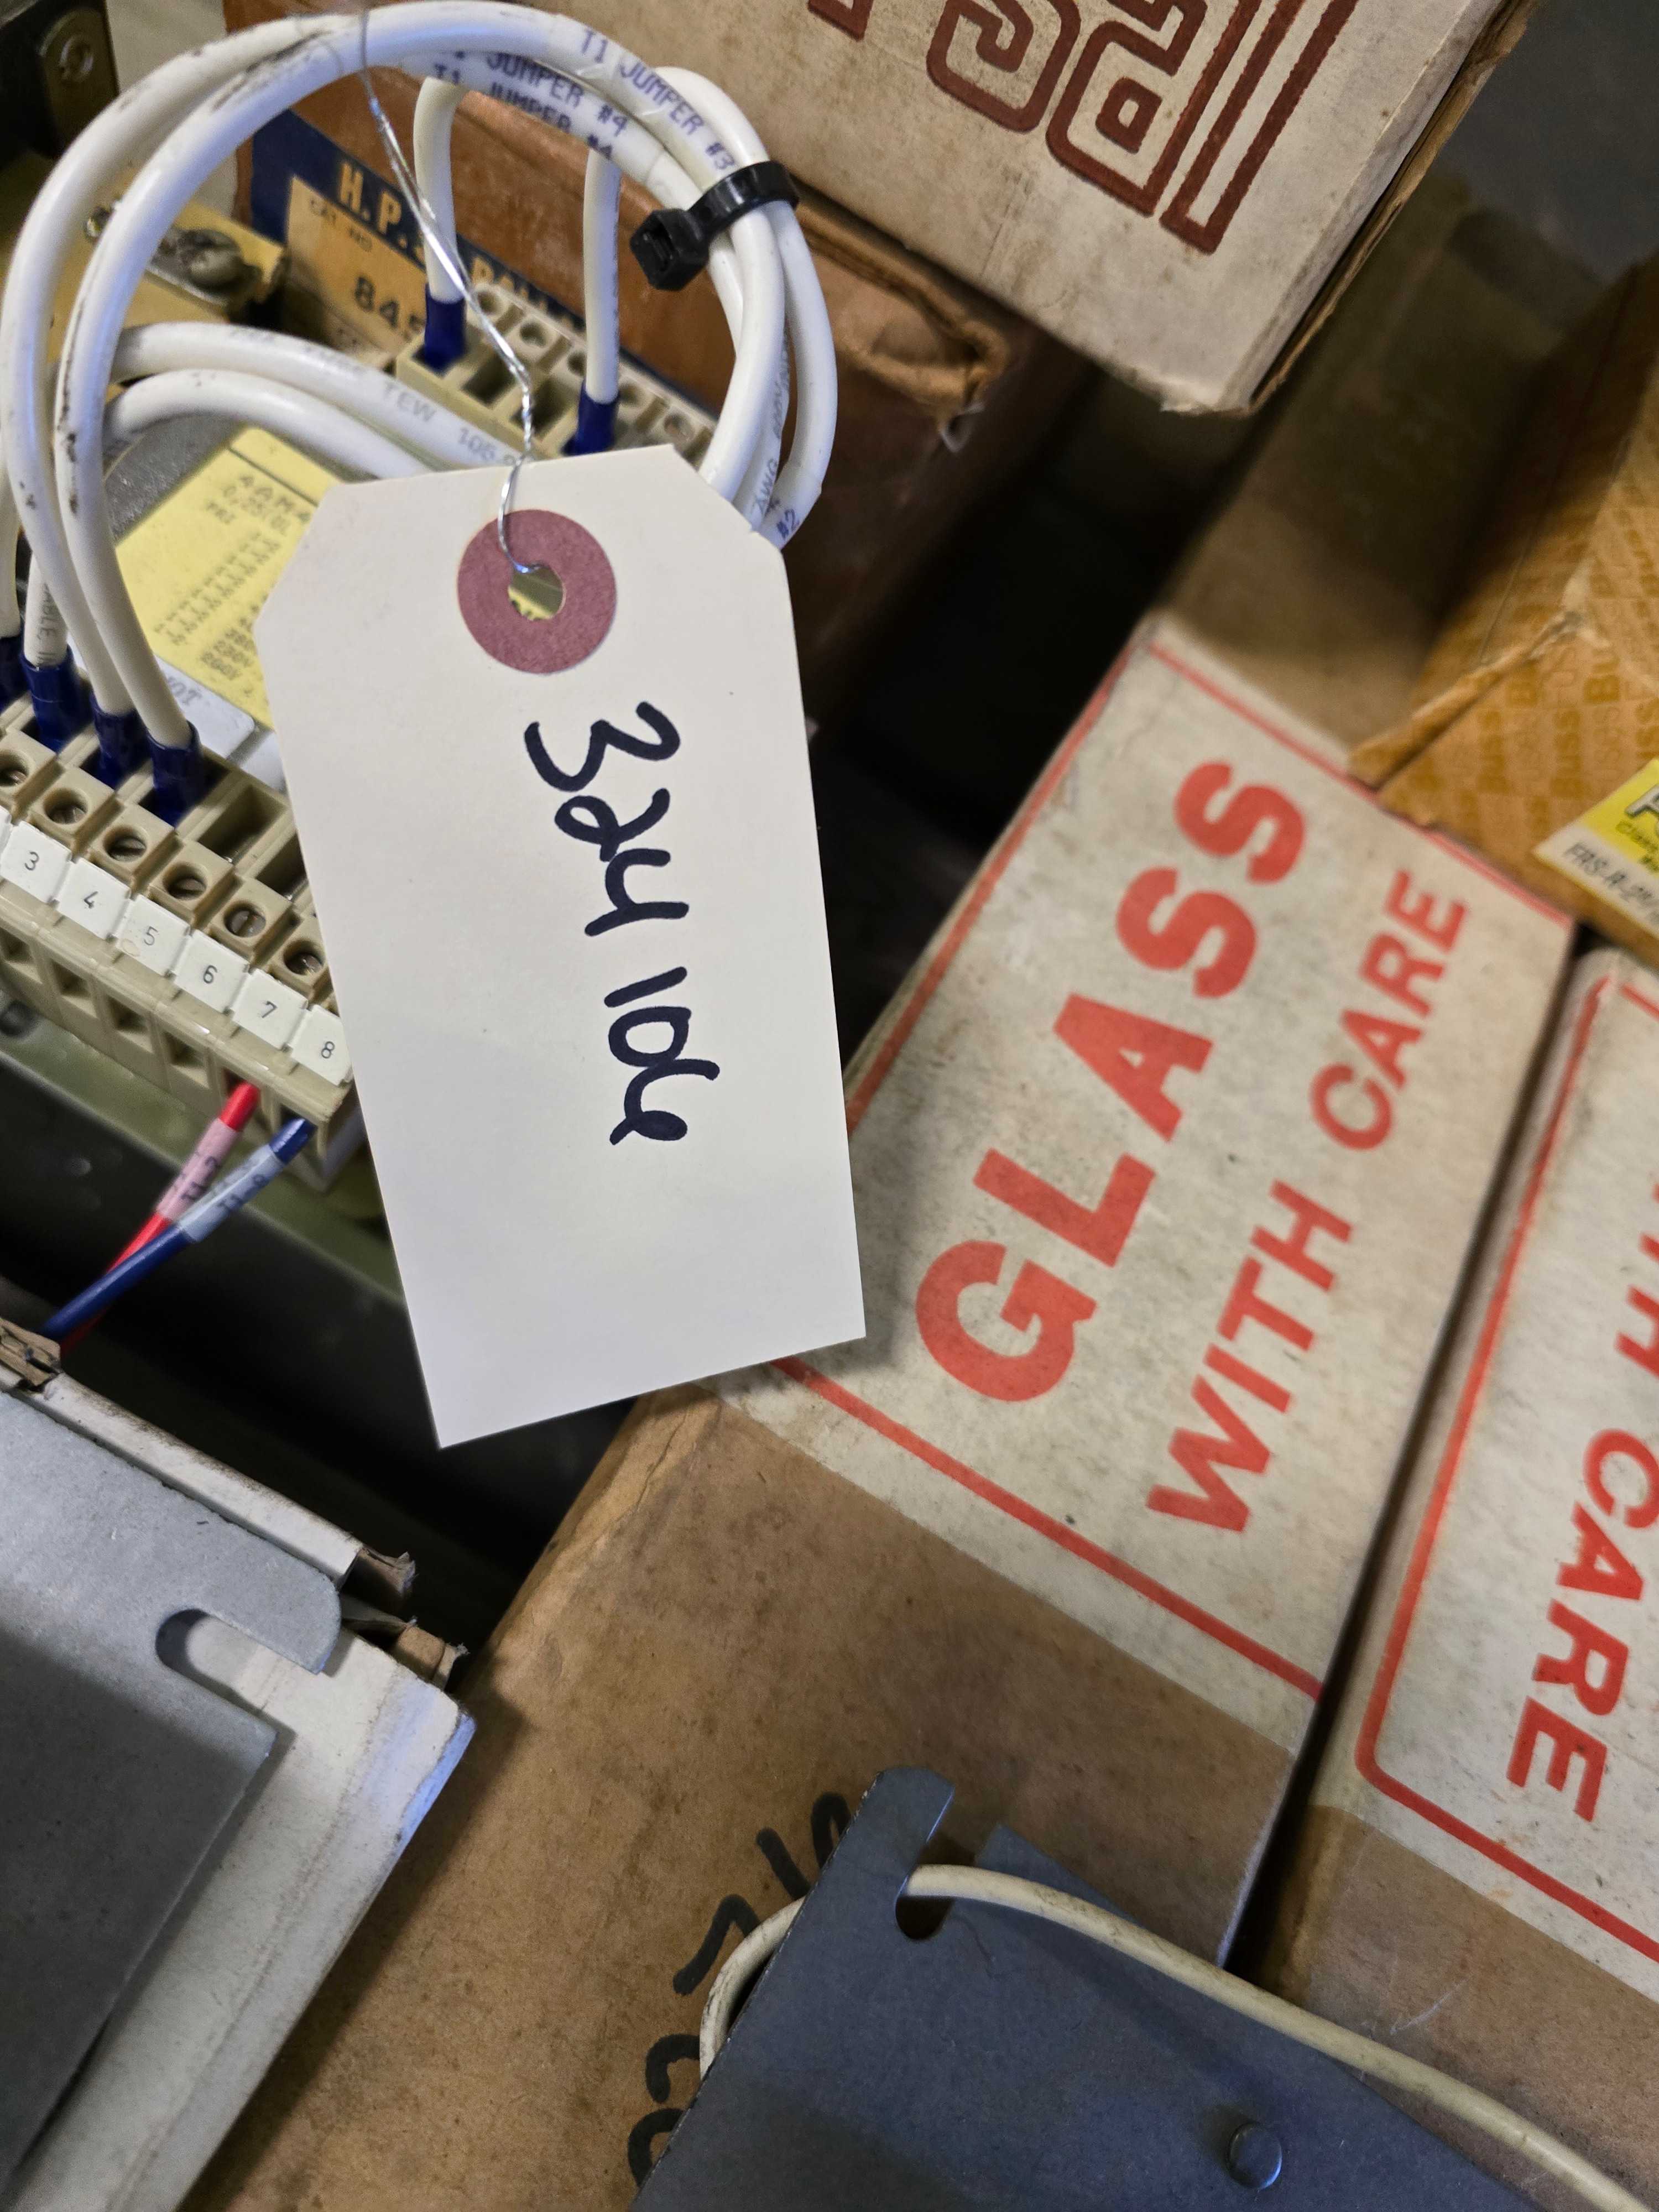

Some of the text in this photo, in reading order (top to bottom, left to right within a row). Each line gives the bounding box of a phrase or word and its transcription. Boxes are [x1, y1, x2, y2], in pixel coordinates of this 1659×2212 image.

[486, 52, 629, 137] JUMPER #4
[580, 29, 735, 170] T1 JUMPER #3
[384, 382, 437, 423] TEW
[523, 701, 690, 937] 324
[24, 852, 40, 872] 3
[84, 890, 100, 910] 4
[143, 926, 160, 946] 5
[202, 964, 218, 984] 6
[262, 1000, 278, 1020] 7
[321, 1040, 336, 1060] 8
[915, 760, 1306, 1403] GLASS
[1145, 869, 1468, 1535] WITH CARE
[1506, 1427, 1659, 1823] CARE
